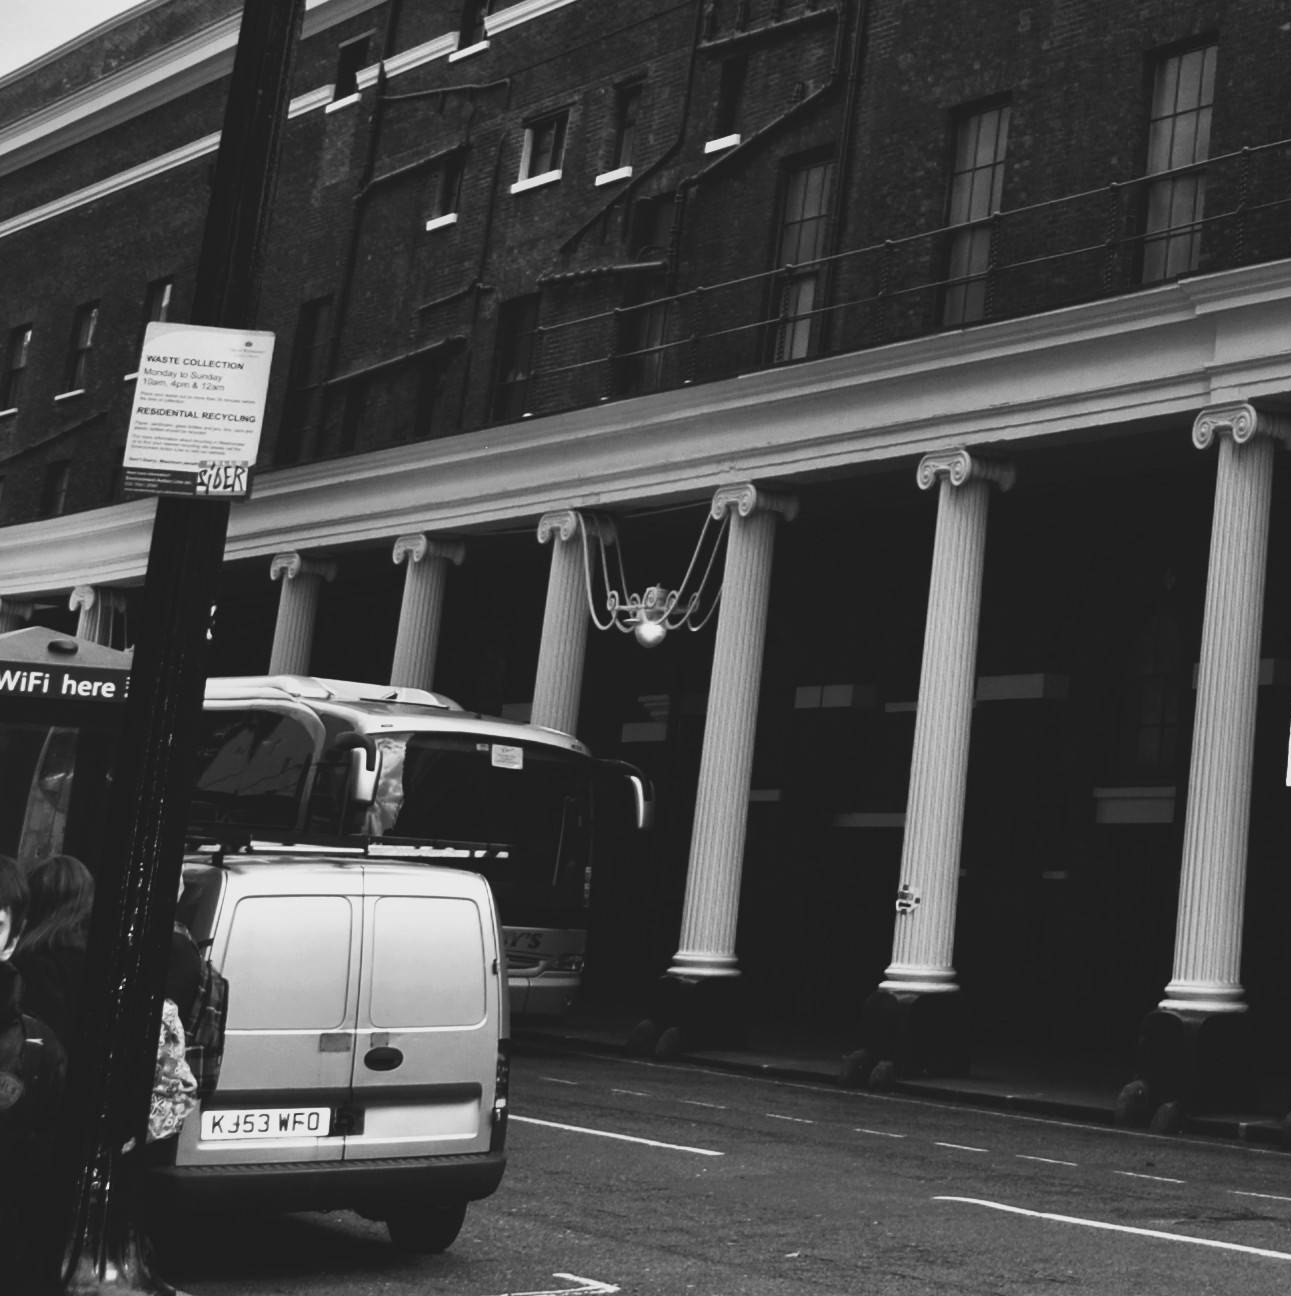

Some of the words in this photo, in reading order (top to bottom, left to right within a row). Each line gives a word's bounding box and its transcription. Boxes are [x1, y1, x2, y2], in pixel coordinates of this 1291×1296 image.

[146, 355, 180, 365] WASTE
[182, 358, 245, 370] COLLECTION
[144, 367, 177, 379] Monday
[180, 370, 189, 378] to
[191, 371, 223, 383] Sunday
[170, 379, 190, 390] 4pm
[136, 406, 199, 419] RESIDENTIAL
[201, 411, 257, 423] RECYCLING
[0, 670, 50, 693] WiFi
[61, 673, 116, 698] here
[211, 1113, 270, 1134] KJ53
